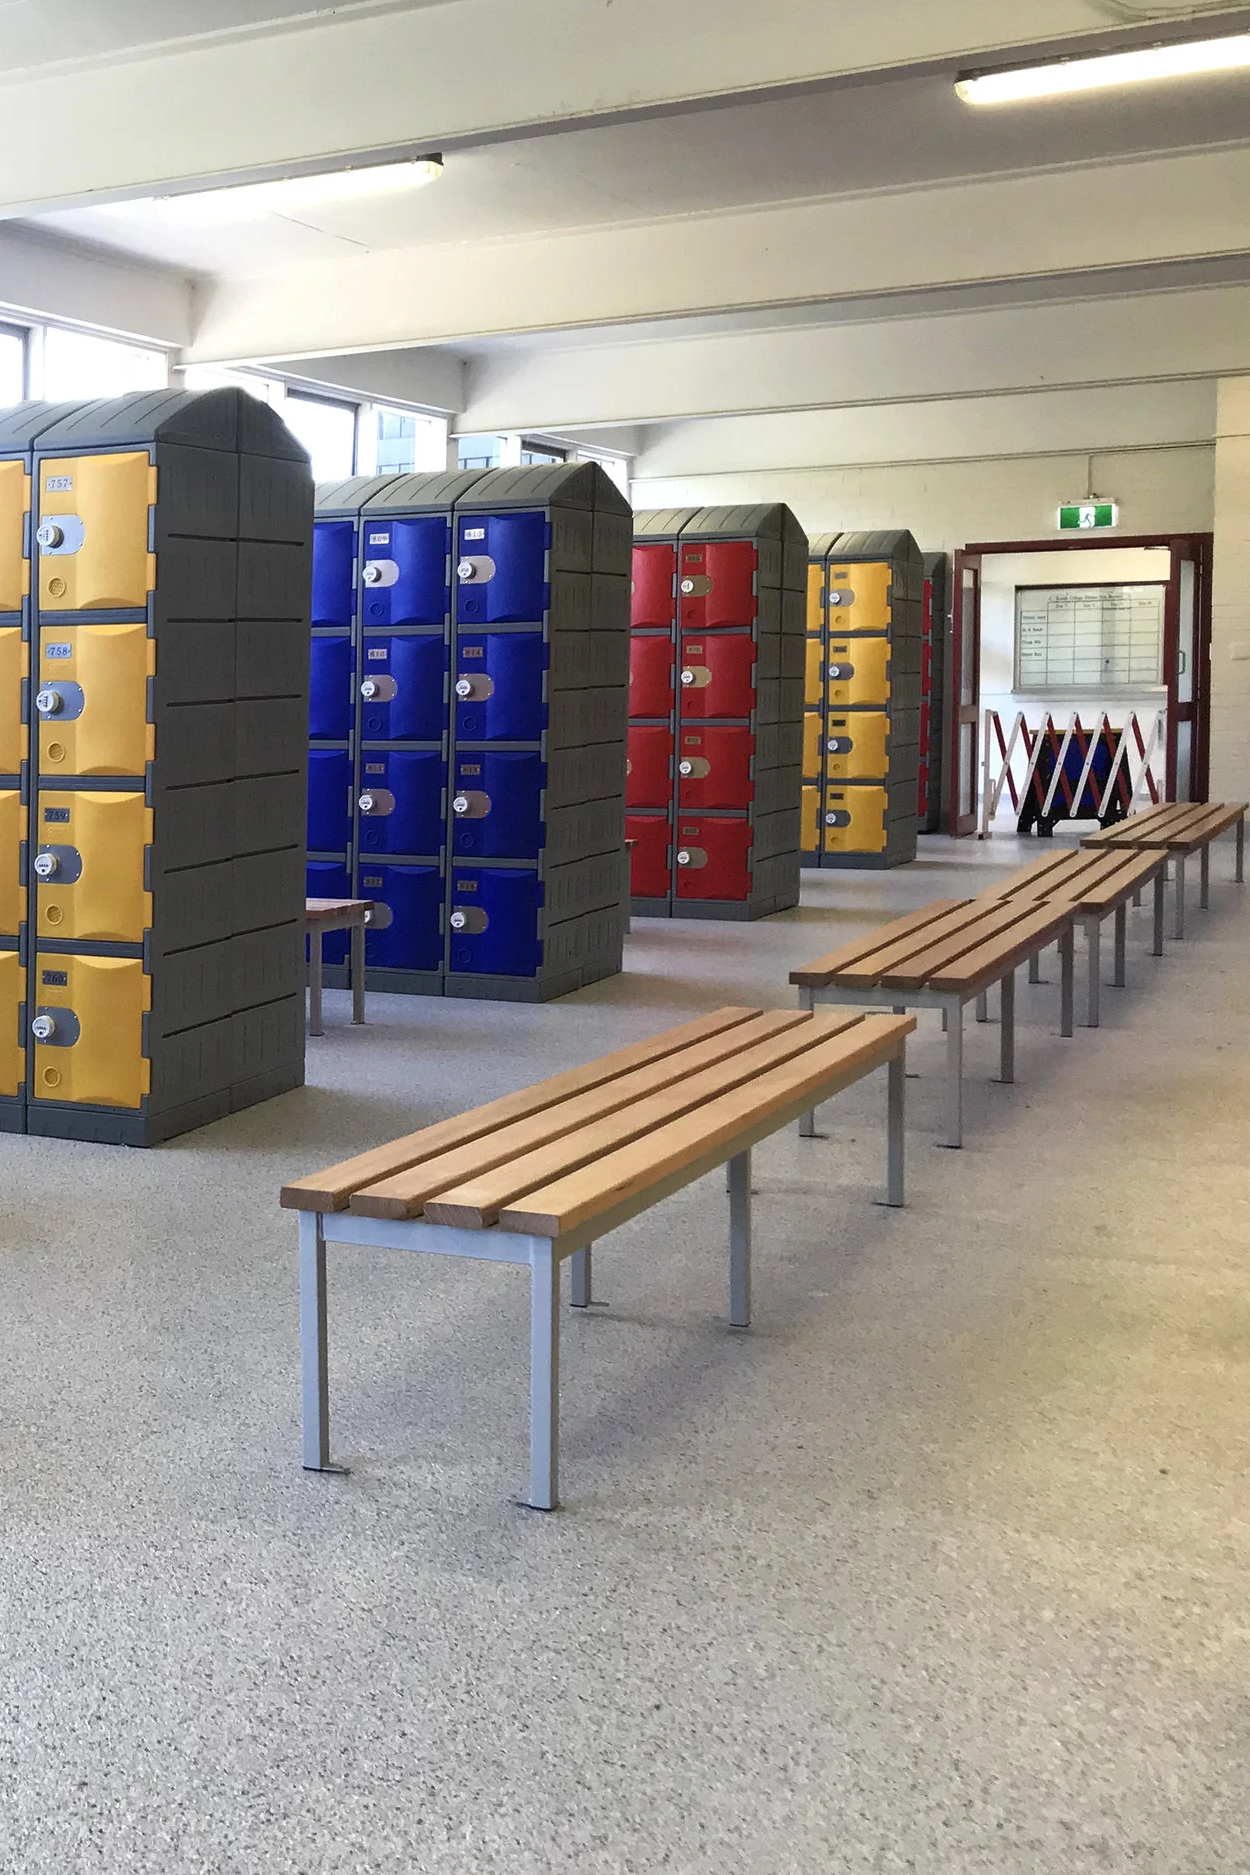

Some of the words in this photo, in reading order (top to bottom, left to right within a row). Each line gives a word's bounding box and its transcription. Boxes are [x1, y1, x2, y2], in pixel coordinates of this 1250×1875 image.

[50, 478, 68, 488] 757
[50, 646, 68, 656] 758
[48, 811, 66, 820] 759
